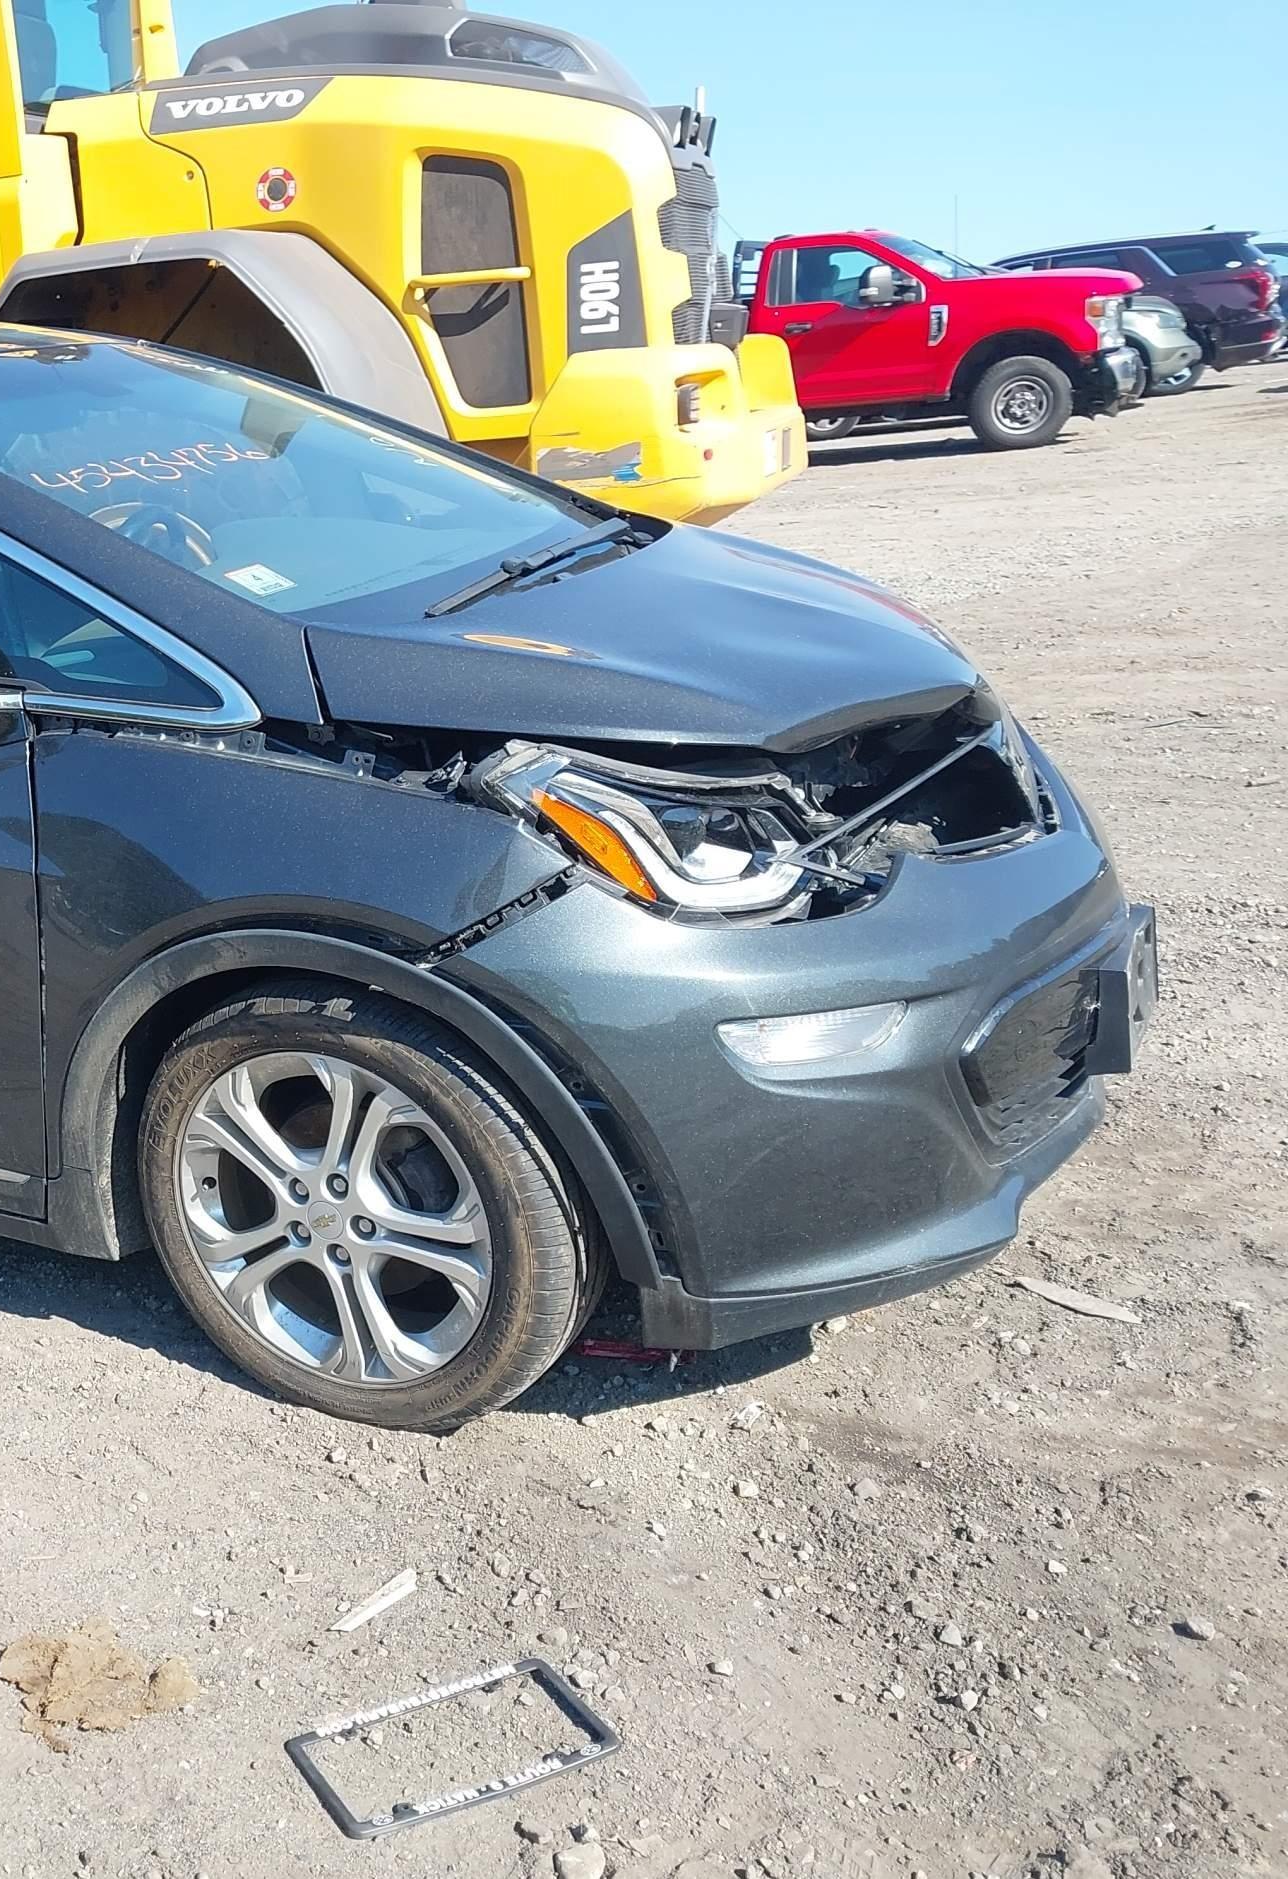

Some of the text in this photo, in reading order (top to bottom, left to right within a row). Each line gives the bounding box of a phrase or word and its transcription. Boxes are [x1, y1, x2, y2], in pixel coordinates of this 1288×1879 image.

[166, 89, 305, 119] VOLVO
[580, 260, 620, 335] L90H
[29, 442, 272, 494] 45434756
[148, 1043, 218, 1153] EVOLUXX
[505, 1757, 563, 1788] ROUTE
[414, 1788, 480, 1815] NATICK
